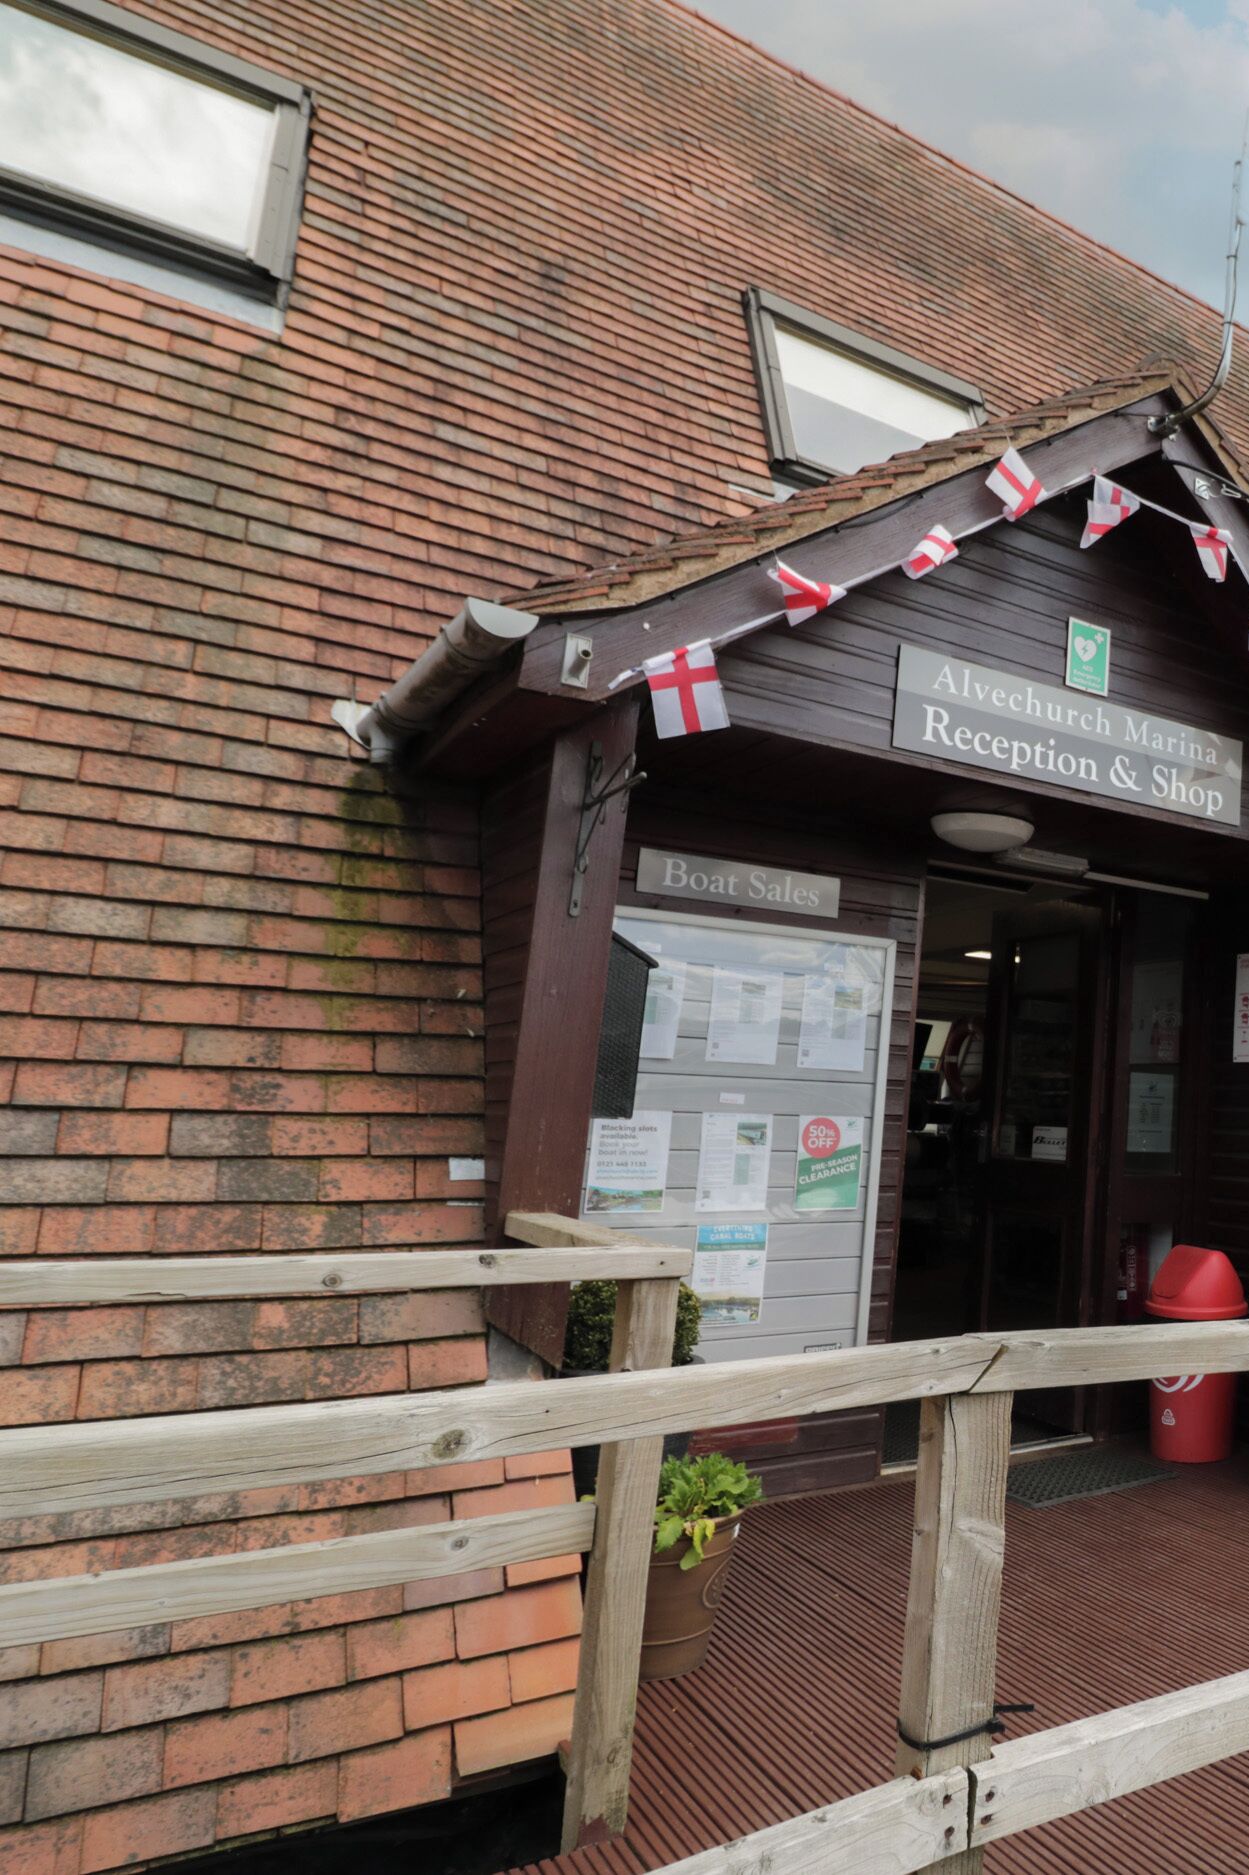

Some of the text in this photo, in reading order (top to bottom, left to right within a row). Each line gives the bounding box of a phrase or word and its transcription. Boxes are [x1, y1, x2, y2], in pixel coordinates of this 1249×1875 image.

[932, 663, 1218, 766] Alvechurch Marina
[921, 703, 1224, 817] Reception & Shop
[661, 857, 820, 907] Boat Sales
[600, 1124, 658, 1133] Blacking slots
[809, 1125, 836, 1137] 50%
[807, 1137, 834, 1149] OFF
[811, 1154, 858, 1172] PRE-SEASON
[799, 1162, 857, 1185] CLEARANCE
